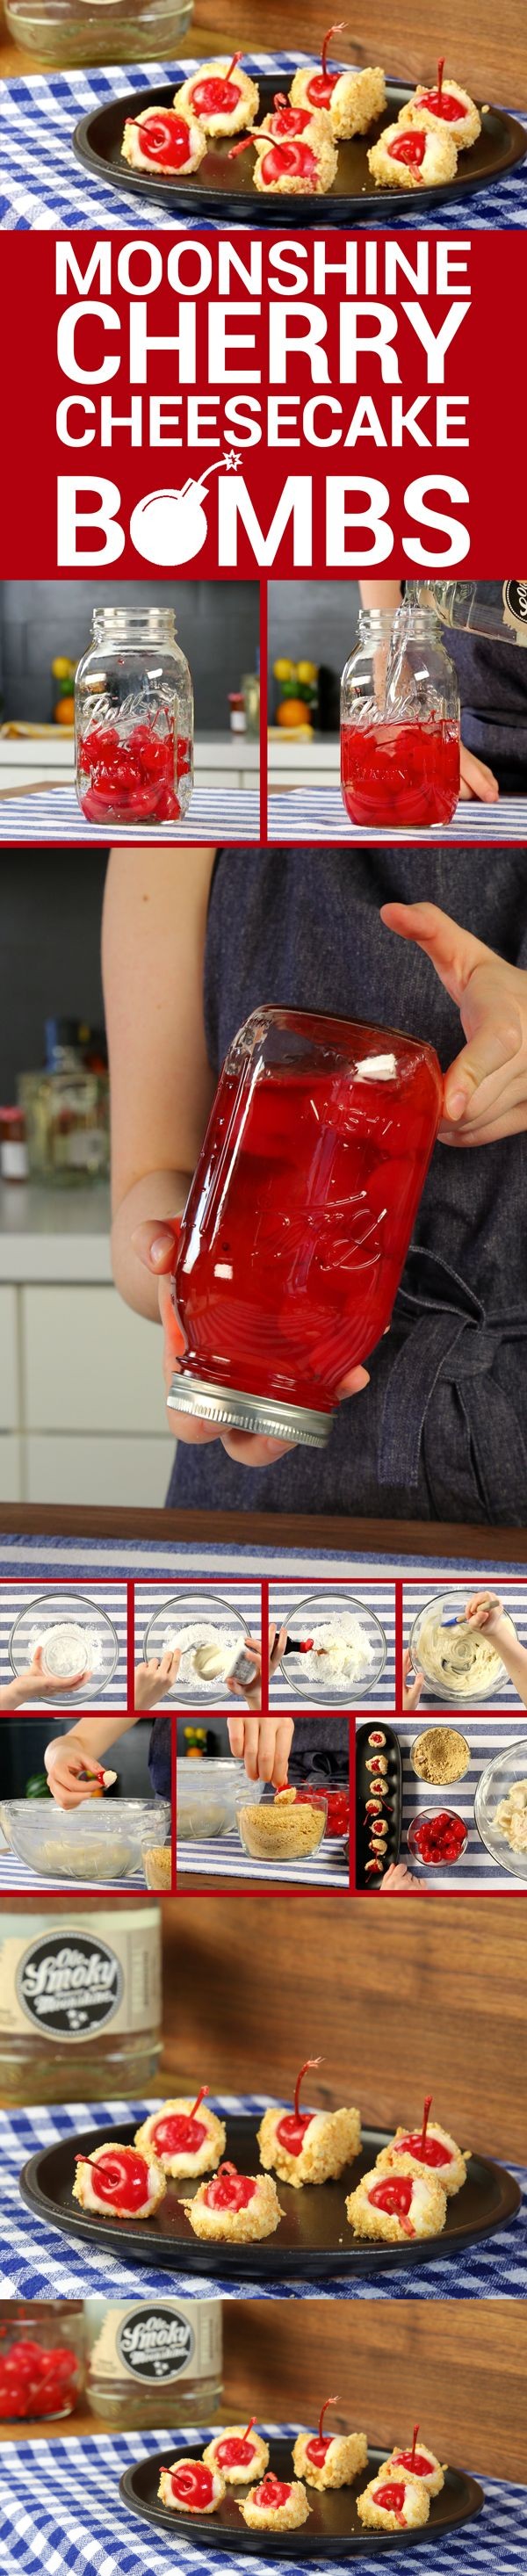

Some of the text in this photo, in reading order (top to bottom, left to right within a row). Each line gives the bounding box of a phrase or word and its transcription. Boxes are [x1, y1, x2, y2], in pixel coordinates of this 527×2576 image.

[83, 690, 148, 734] Ball
[21, 1954, 119, 1995] Smoky
[56, 1947, 90, 1968] Ole
[120, 2321, 191, 2352] Smoky
